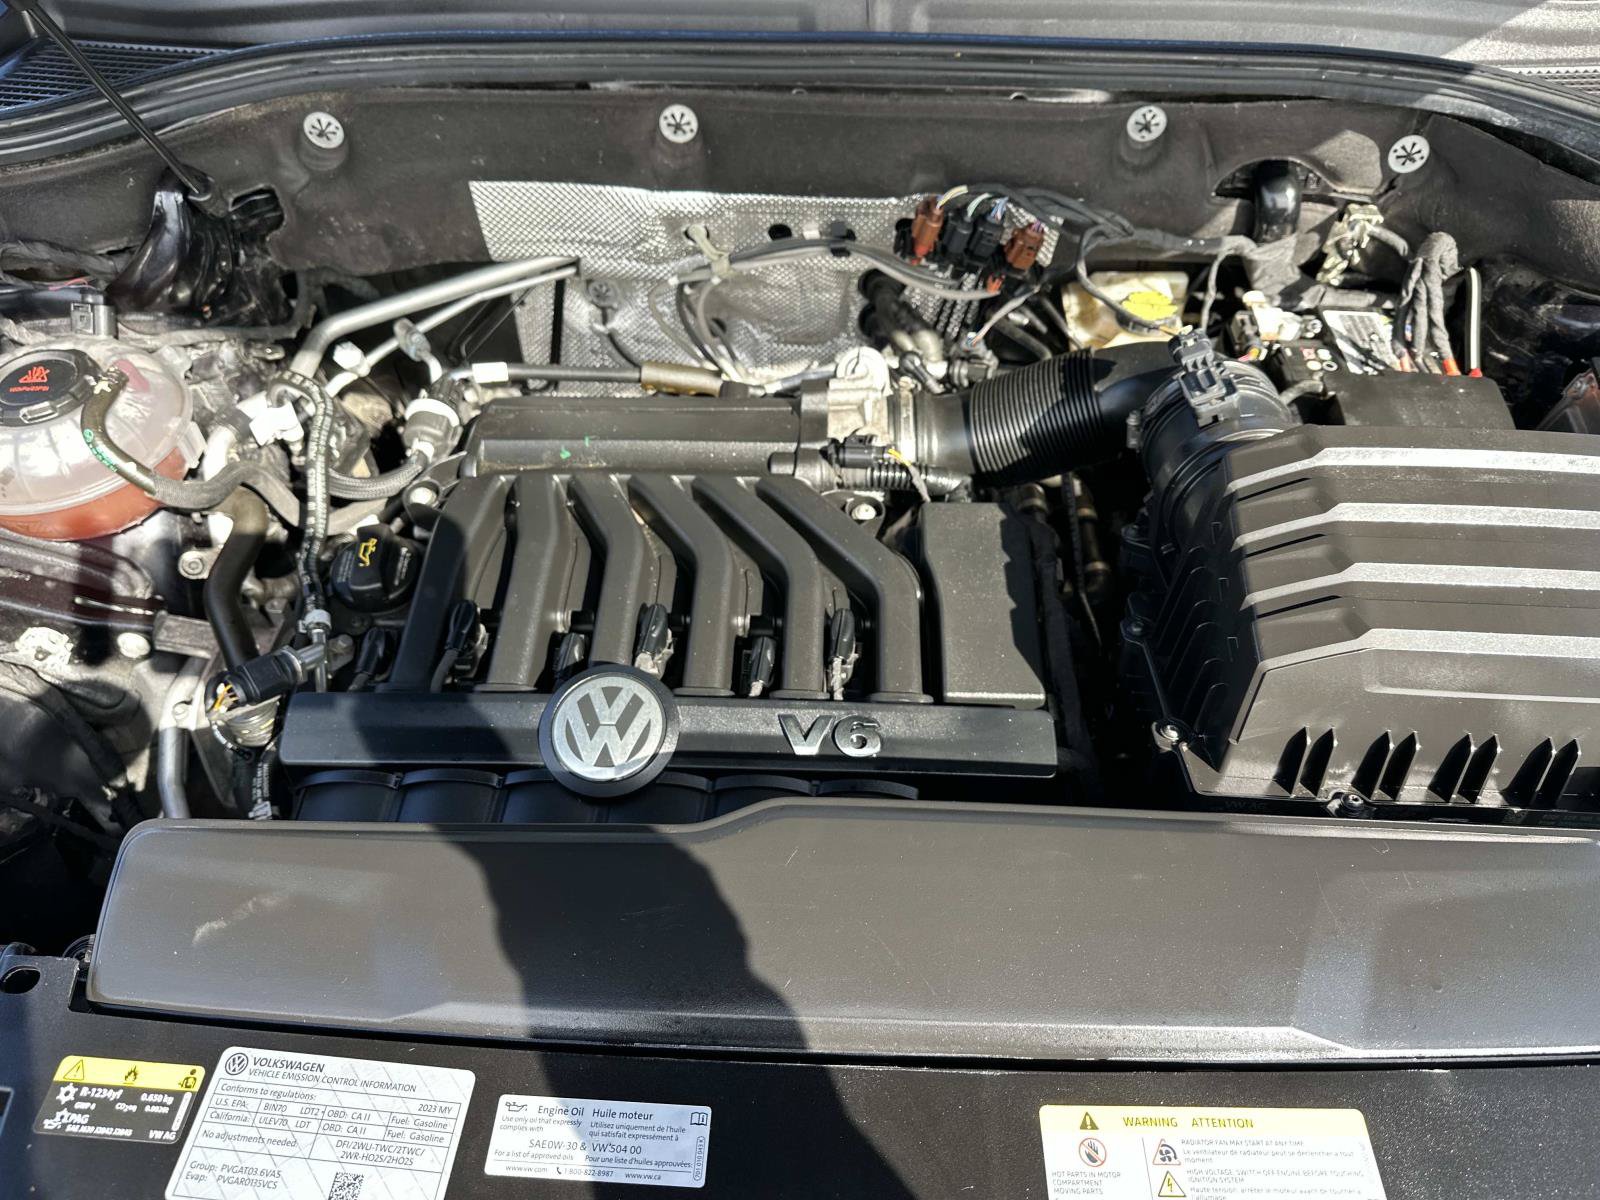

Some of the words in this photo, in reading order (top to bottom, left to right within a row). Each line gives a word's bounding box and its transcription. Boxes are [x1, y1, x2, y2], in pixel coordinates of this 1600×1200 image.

[777, 713, 882, 758] V6
[253, 1056, 325, 1073] VOLKSWAGEN
[249, 1069, 280, 1079] VEHICLE
[281, 1070, 321, 1082] EMISSION
[322, 1075, 358, 1087] CONTROL
[360, 1080, 417, 1092] INFORMATION
[79, 1087, 123, 1101] R-1234yf
[221, 1083, 259, 1095] Conforms
[260, 1087, 269, 1096] to
[270, 1090, 316, 1101] regulations:
[418, 1103, 437, 1112] 2023
[438, 1106, 453, 1114] MY
[538, 1105, 569, 1117] Engine
[571, 1107, 585, 1116] Oil
[592, 1108, 617, 1119] Huile
[618, 1112, 653, 1121] moteur
[210, 1110, 250, 1123] California:
[514, 1116, 528, 1124] only
[552, 1119, 582, 1128] expressly
[1122, 1117, 1178, 1128] WARNING
[1191, 1117, 1254, 1128] ATTENTION
[295, 1120, 312, 1129] LDT
[413, 1118, 448, 1130] Gasoline
[590, 1121, 614, 1129] Utilisez
[615, 1123, 655, 1132] uniquement
[203, 1130, 214, 1139] No
[215, 1132, 266, 1145] adjustments
[410, 1132, 445, 1143] Gasoline
[589, 1130, 600, 1138] qui
[601, 1131, 627, 1139] satisfait
[579, 1142, 587, 1150] &
[531, 1152, 562, 1160] approved
[585, 1155, 600, 1163] Pour
[190, 1160, 219, 1173] Group:
[185, 1171, 208, 1183] Evap:
[1052, 1179, 1102, 1187] COMPARTMENT
